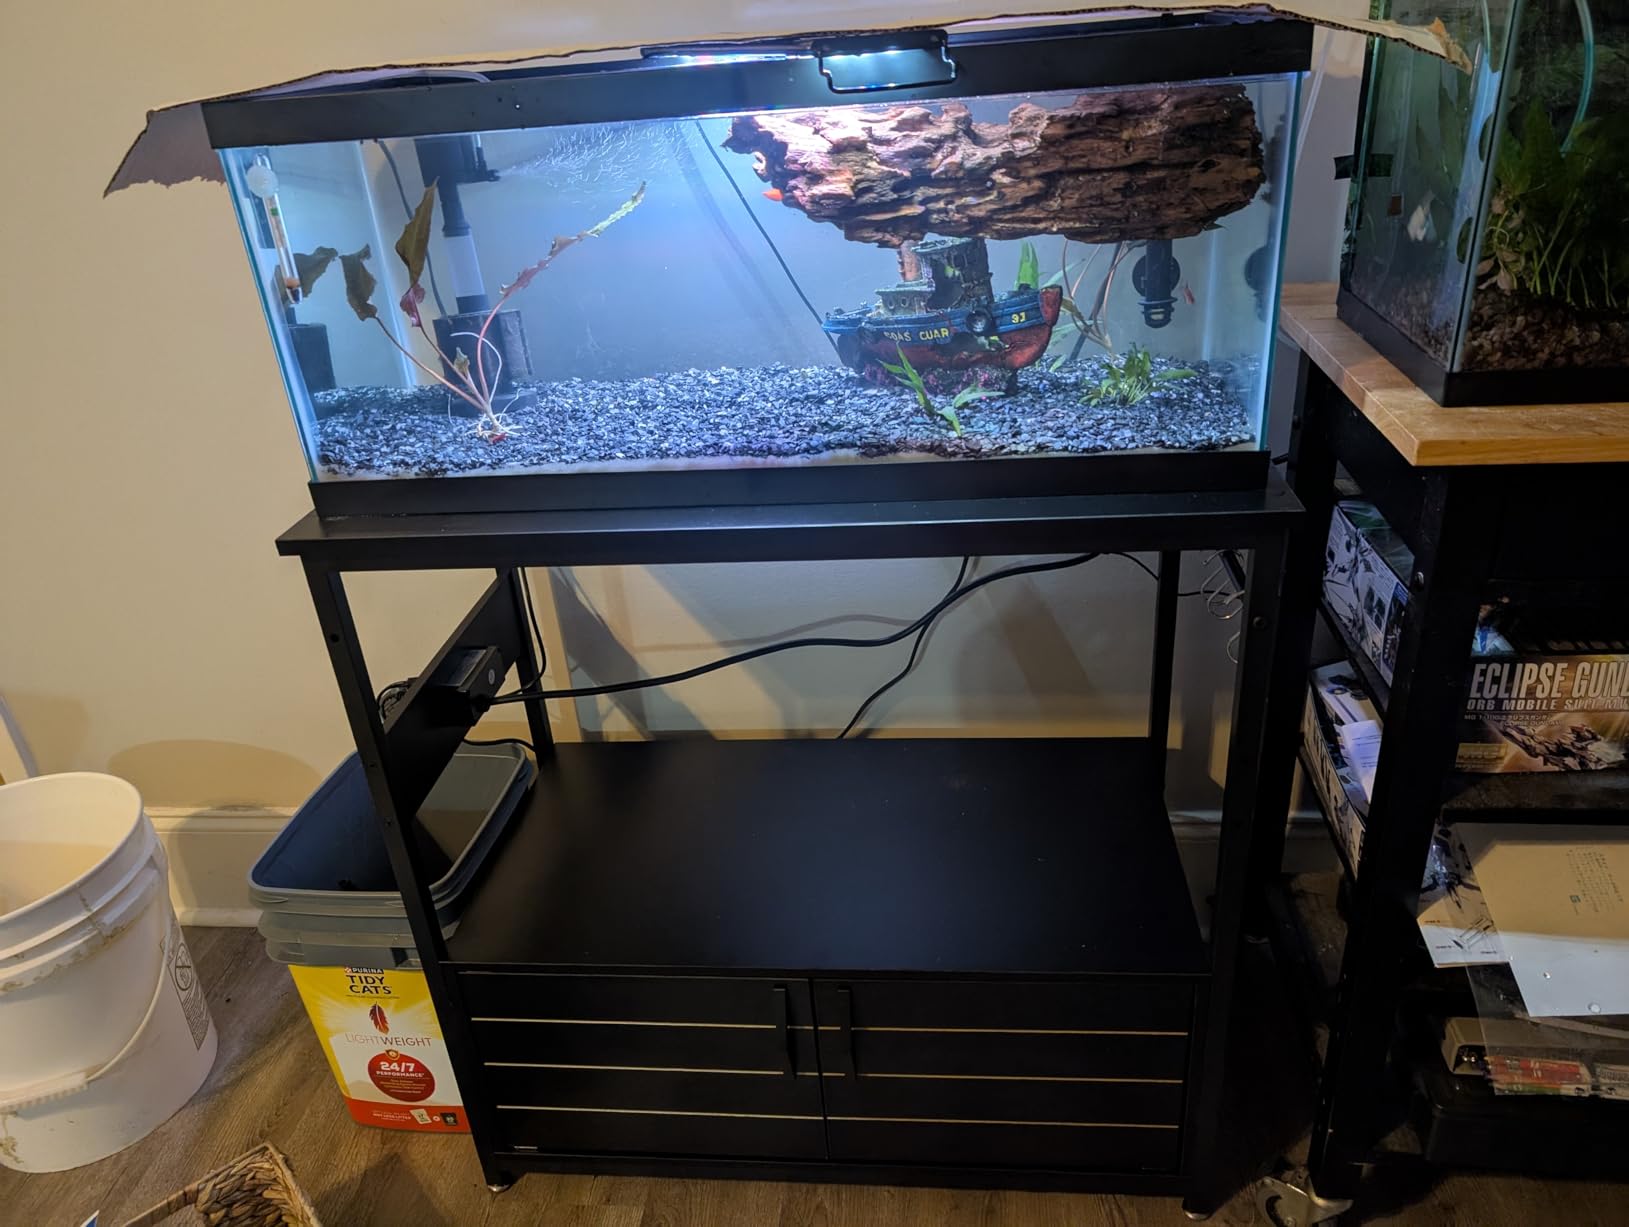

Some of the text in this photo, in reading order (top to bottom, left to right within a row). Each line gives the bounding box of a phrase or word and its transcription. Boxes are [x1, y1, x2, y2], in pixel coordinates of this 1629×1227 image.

[1469, 661, 1569, 699] ECLIPSE
[1466, 699, 1496, 711] ORB
[1501, 699, 1558, 711] MOBILE
[345, 974, 385, 985] TIDY
[349, 985, 392, 995] CATS
[345, 1033, 432, 1047] LIGHTWEIGHT
[379, 1061, 415, 1073] 24/7
